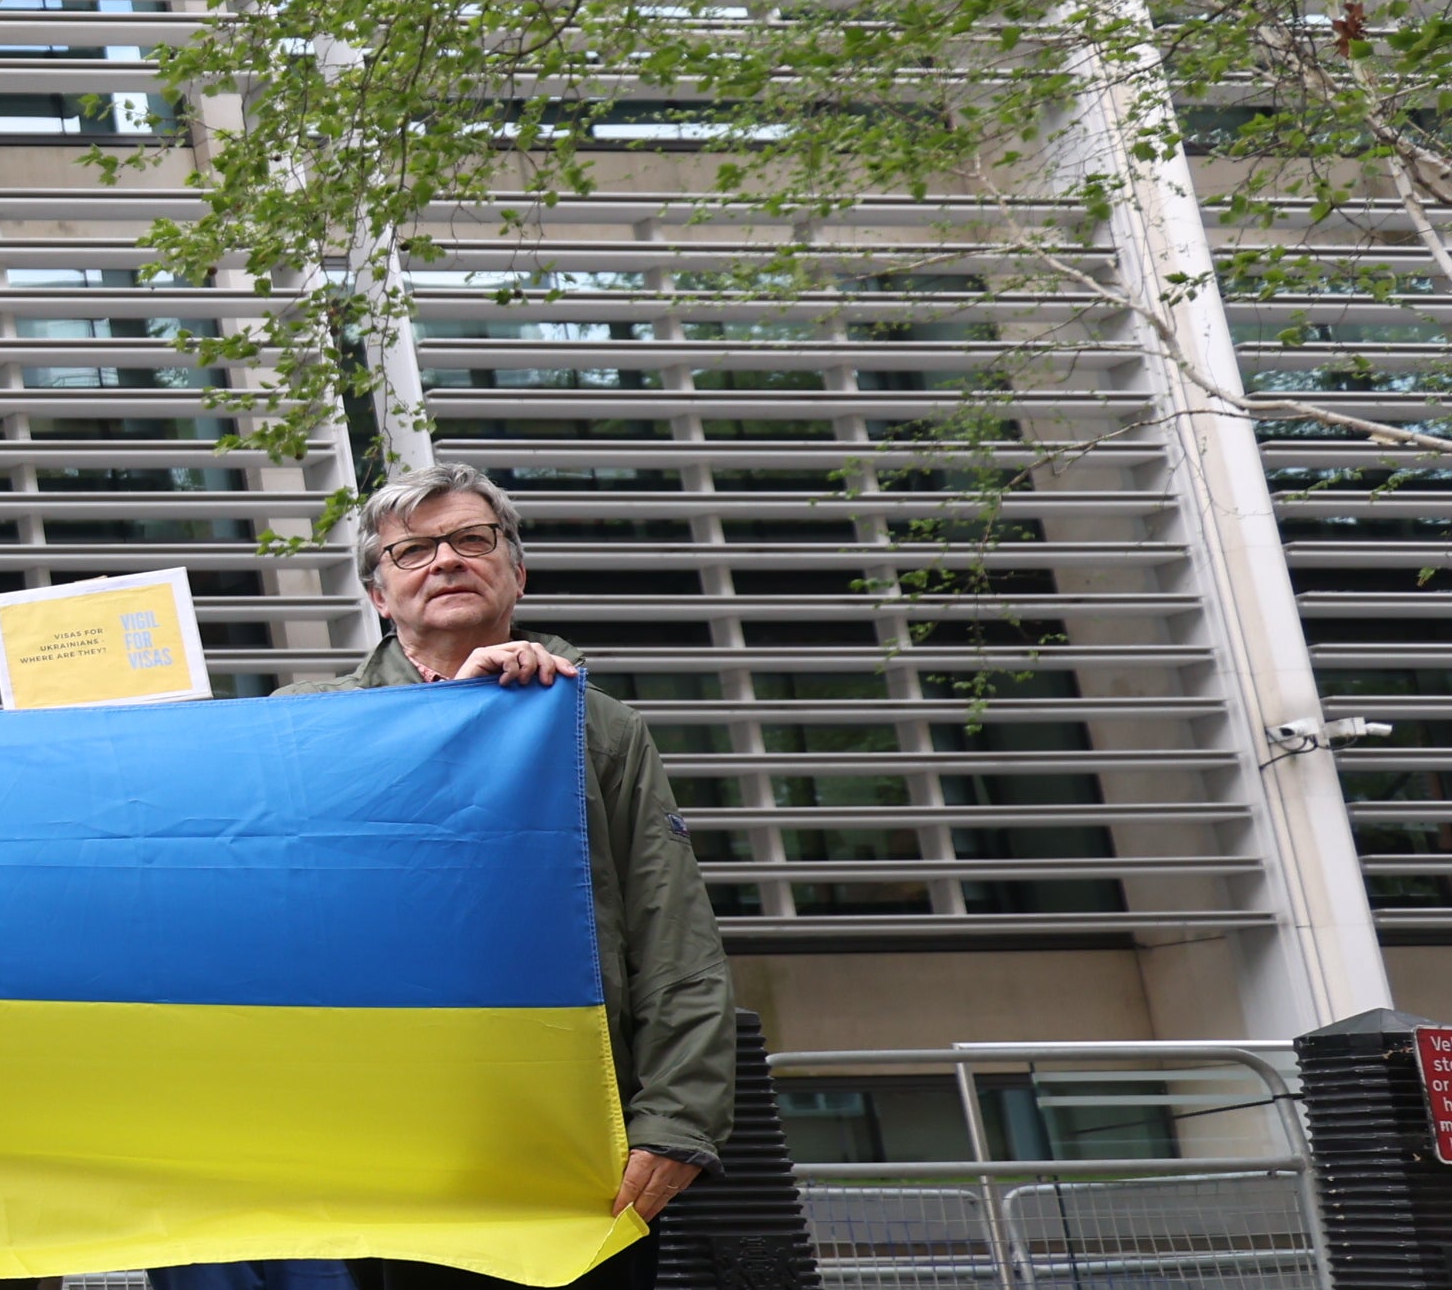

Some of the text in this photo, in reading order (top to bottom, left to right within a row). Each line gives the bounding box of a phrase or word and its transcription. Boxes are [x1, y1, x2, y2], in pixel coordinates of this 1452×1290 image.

[120, 611, 160, 631] VIGIL
[54, 628, 103, 641] VISAS FOR
[124, 631, 152, 651] FOR
[40, 639, 99, 652] UKRAINIANS
[20, 647, 106, 664] WHERE ARE THEY?
[128, 648, 172, 670] VISAS
[1432, 1079, 1450, 1091] or
